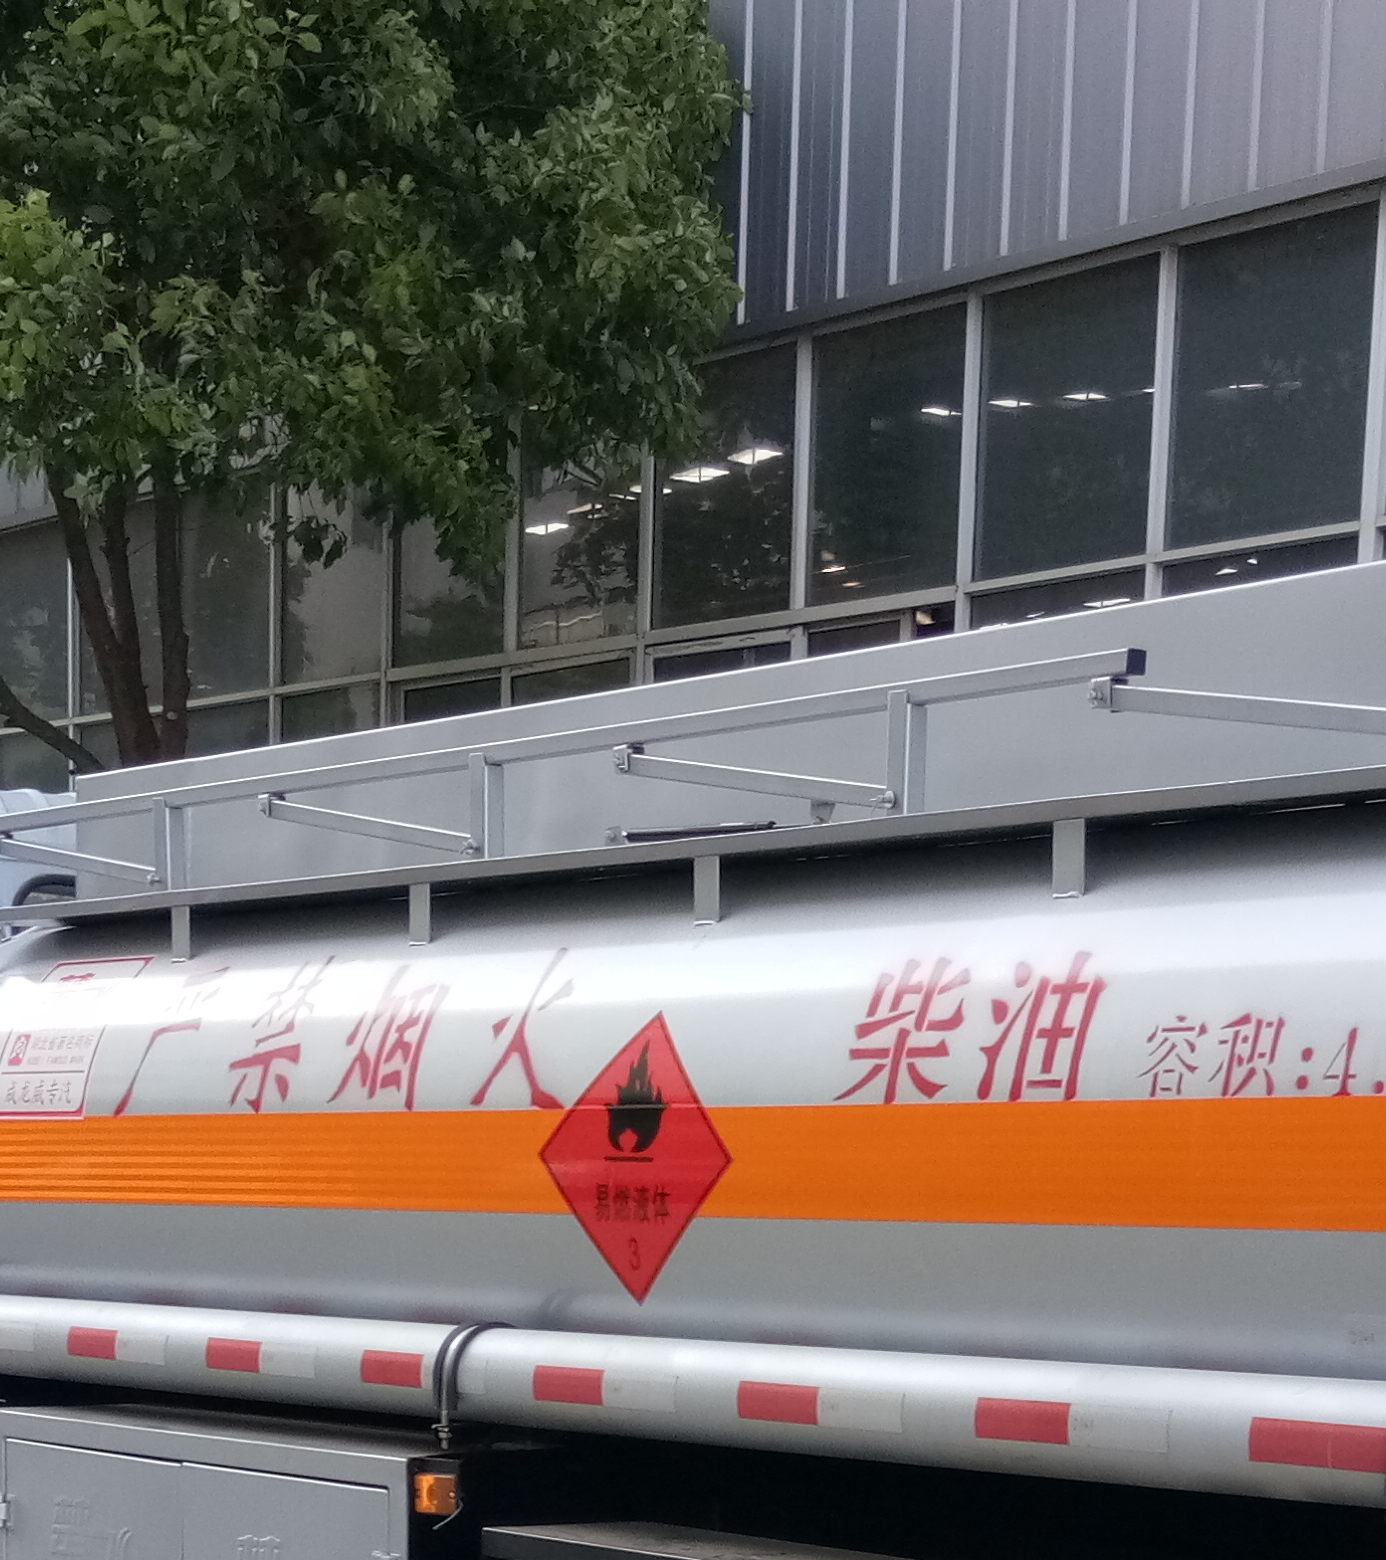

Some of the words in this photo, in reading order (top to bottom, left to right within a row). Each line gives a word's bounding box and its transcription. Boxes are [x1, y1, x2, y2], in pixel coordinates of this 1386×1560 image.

[113, 948, 575, 1116] 严禁烟火
[833, 951, 1108, 1105] 柴油
[627, 1236, 641, 1271] 3
